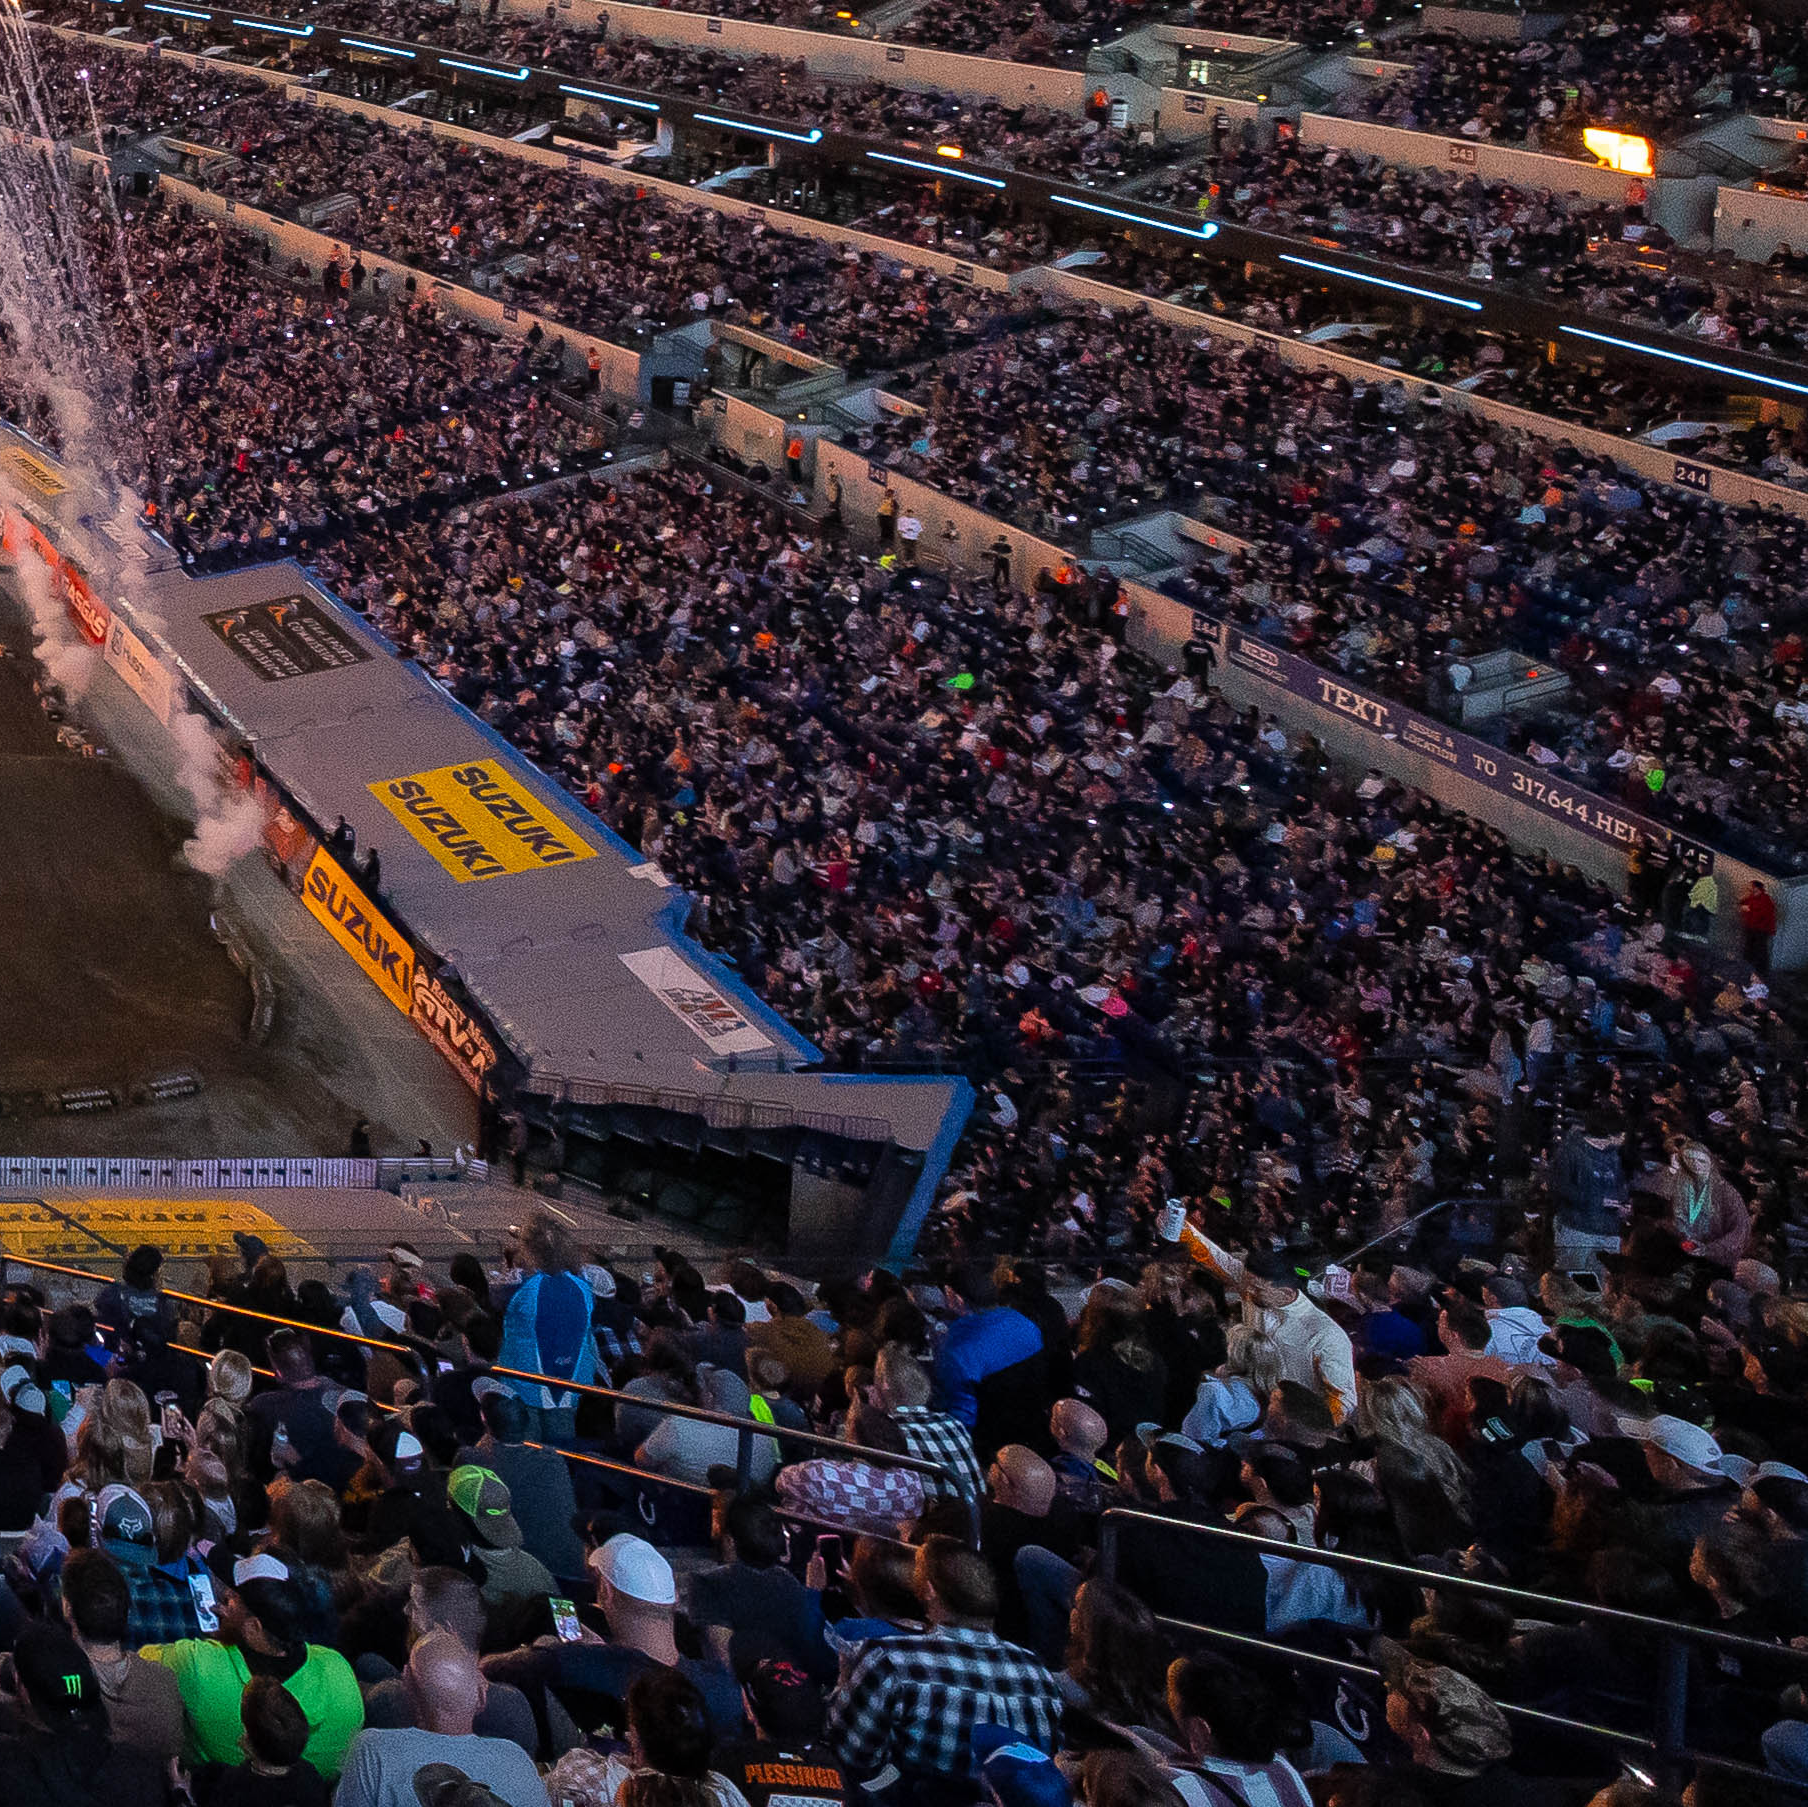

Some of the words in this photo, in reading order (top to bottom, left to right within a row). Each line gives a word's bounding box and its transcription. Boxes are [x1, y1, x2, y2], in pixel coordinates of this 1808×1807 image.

[1450, 146, 1474, 161] 343
[1676, 465, 1707, 487] 244
[1402, 731, 1457, 764] LOCATION
[1472, 753, 1498, 777] TO
[389, 778, 507, 878] SUZUKI
[453, 765, 575, 864] SUZUKI
[307, 865, 409, 993] SUZUKI
